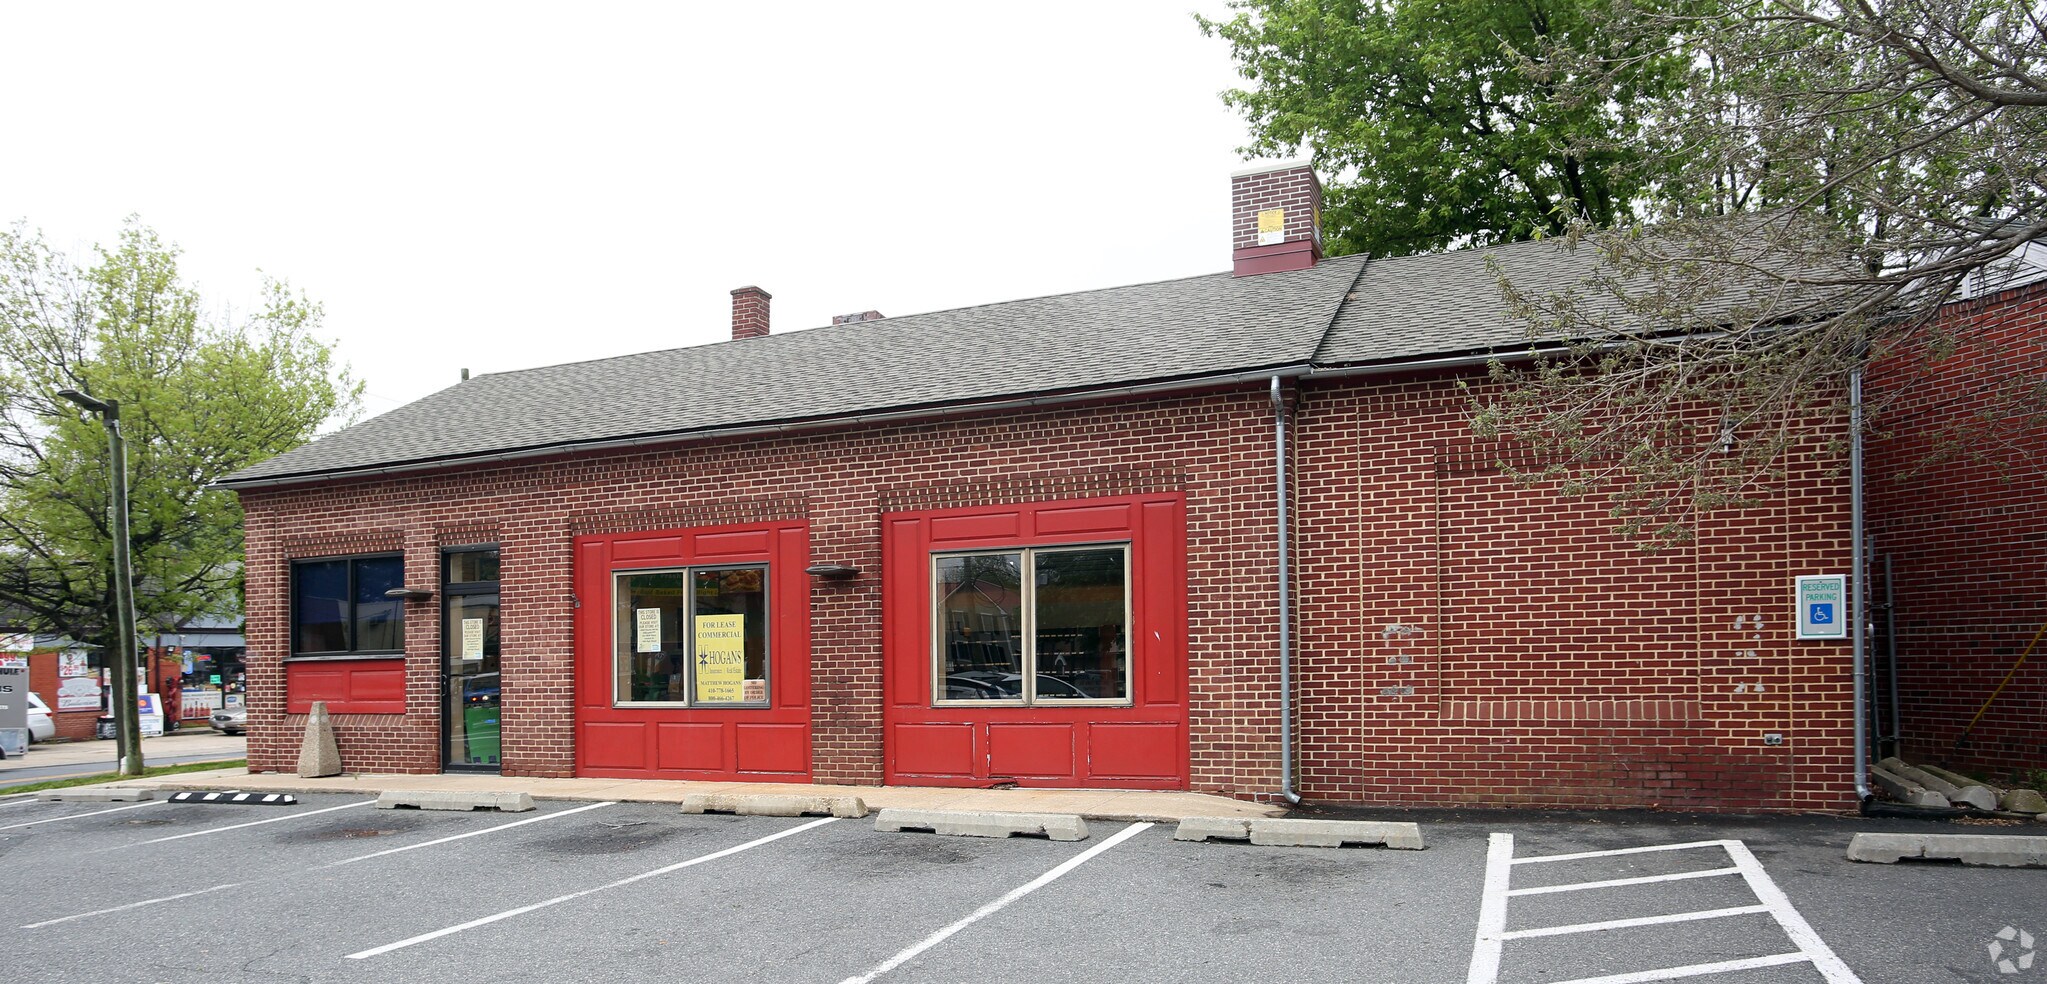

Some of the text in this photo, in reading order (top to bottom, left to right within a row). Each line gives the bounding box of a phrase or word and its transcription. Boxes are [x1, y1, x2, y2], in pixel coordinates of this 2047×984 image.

[1802, 583, 1839, 591] RESERVED
[1806, 593, 1837, 601] PARKING
[702, 621, 715, 629] FOR
[698, 631, 742, 639] COMMERCIAL
[709, 650, 742, 665] HOGANS
